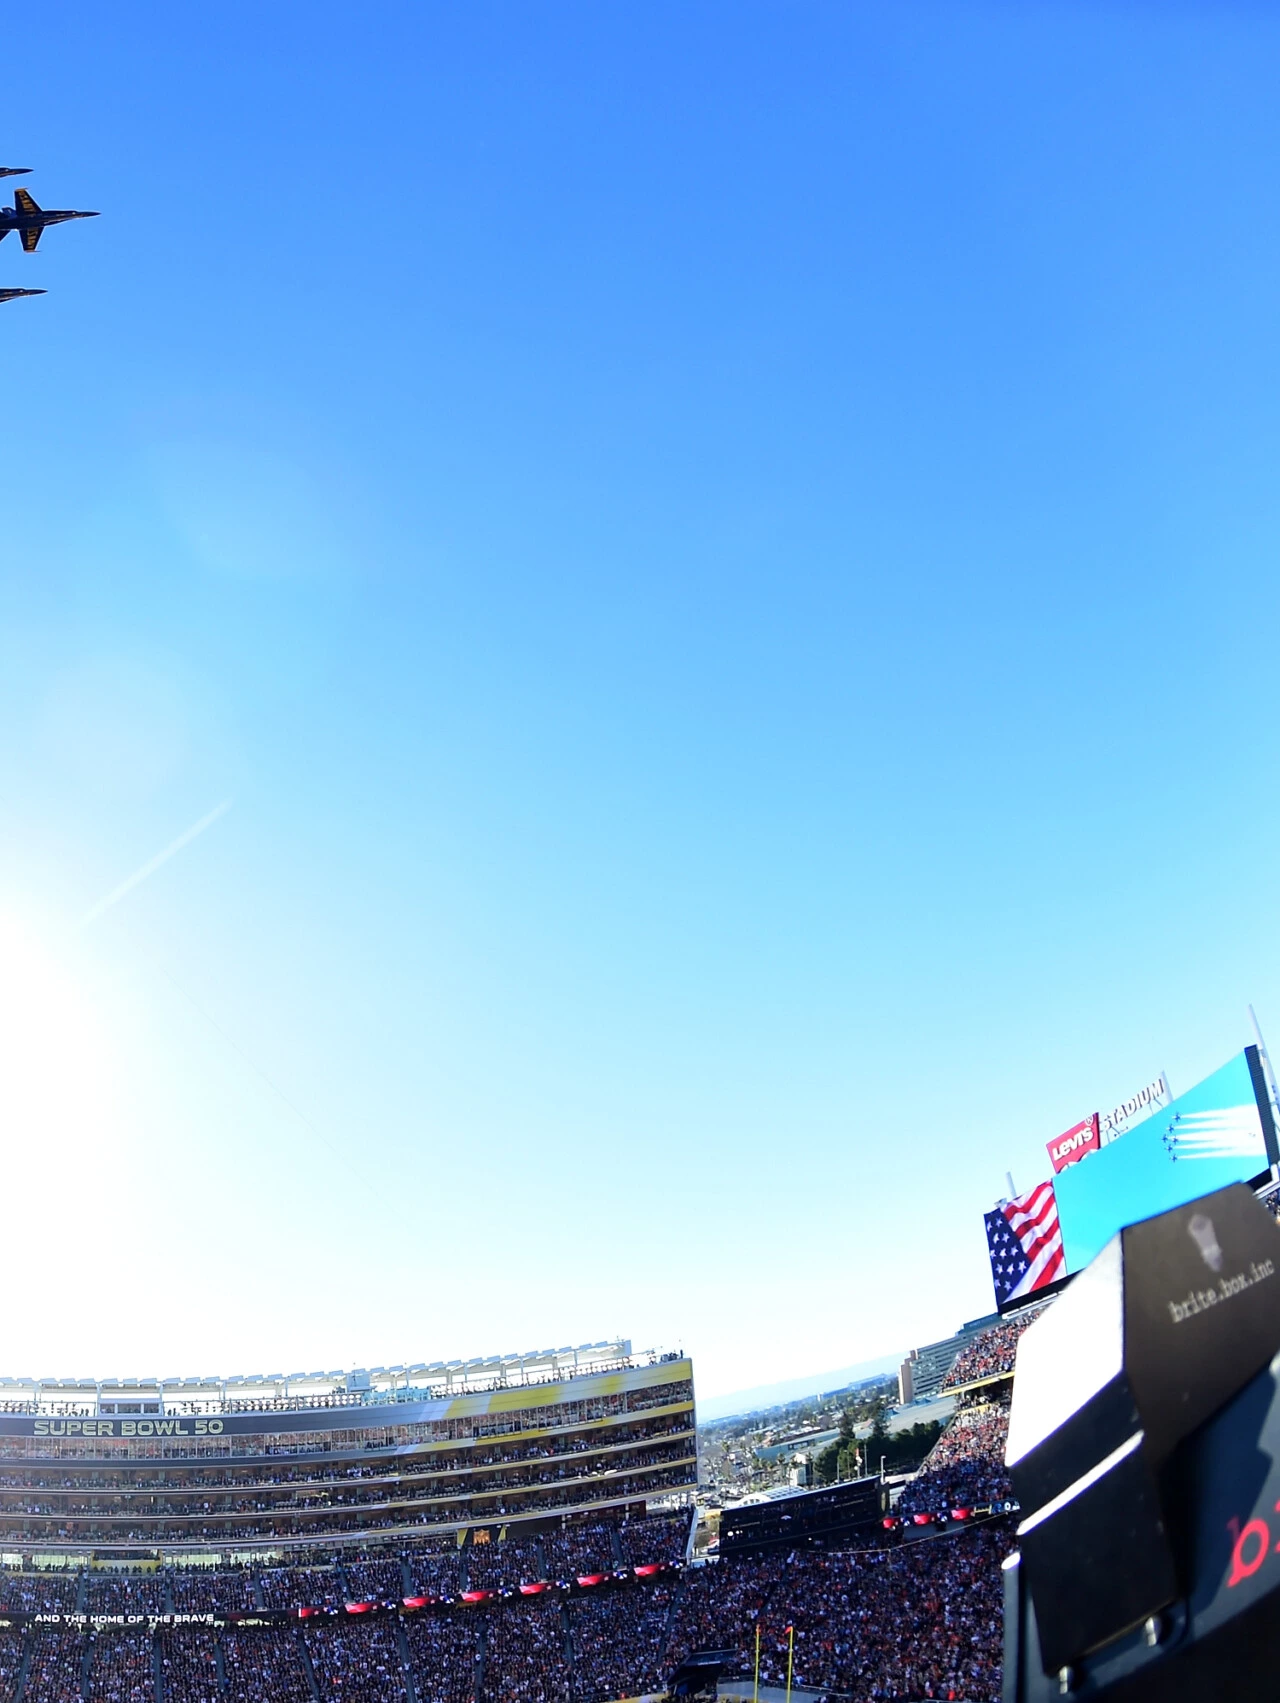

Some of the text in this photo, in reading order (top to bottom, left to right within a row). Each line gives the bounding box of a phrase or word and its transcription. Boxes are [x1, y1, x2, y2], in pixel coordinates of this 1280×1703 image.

[1101, 1079, 1164, 1133] STADIUM
[1168, 1258, 1276, 1324] brite.box.inc
[33, 1419, 224, 1437] SUPER BOWL 50
[34, 1613, 215, 1624] AND THE HOME OF THE BRAVE
